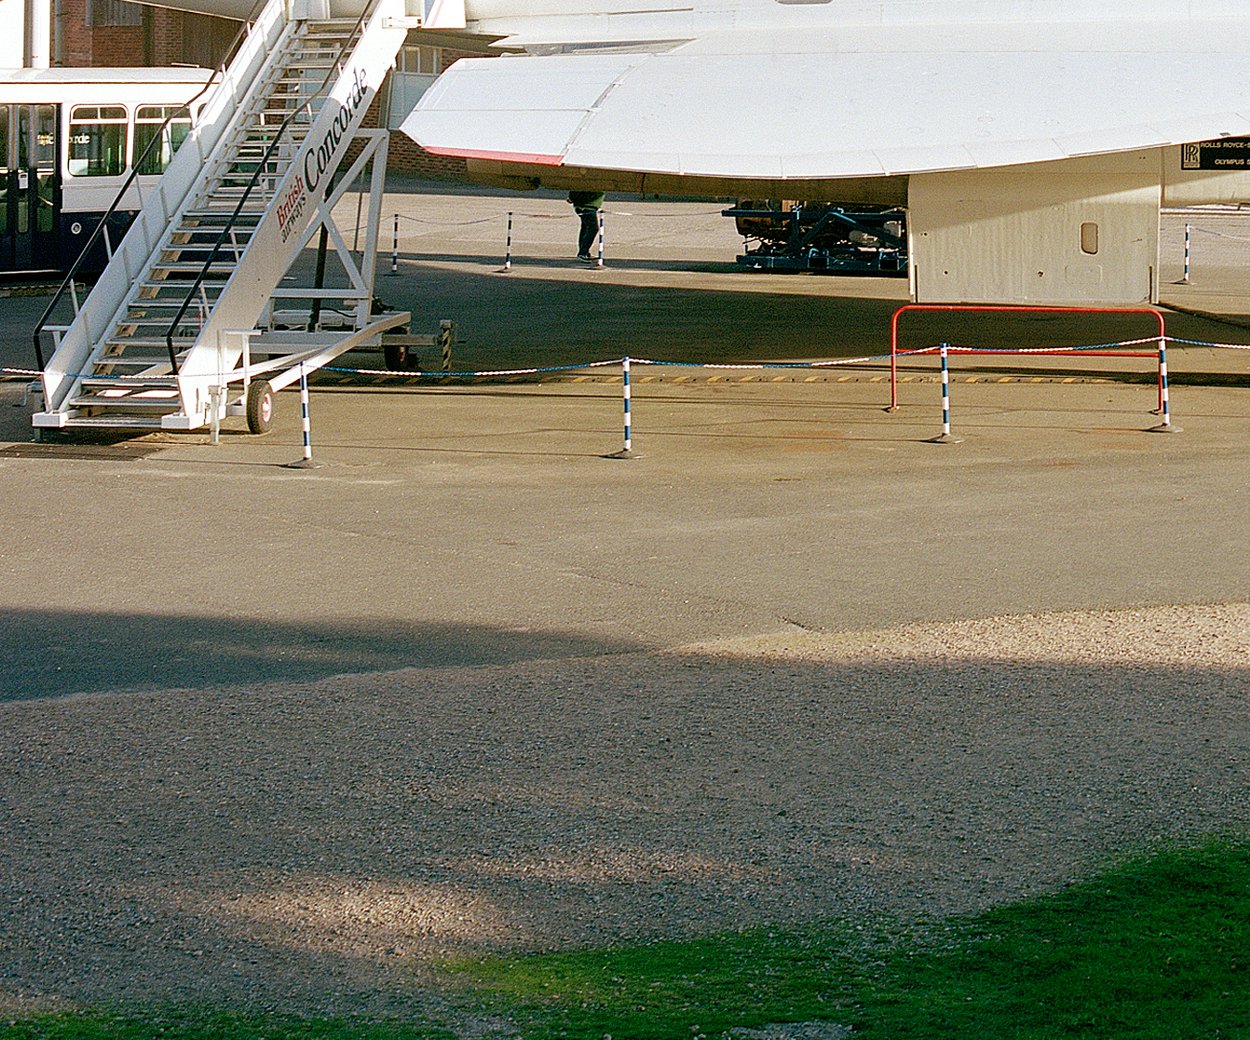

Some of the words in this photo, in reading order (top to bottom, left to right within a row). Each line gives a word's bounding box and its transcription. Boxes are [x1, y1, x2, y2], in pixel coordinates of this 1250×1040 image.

[304, 66, 368, 193] Concorde
[276, 175, 304, 230] British
[282, 192, 307, 243] airways
